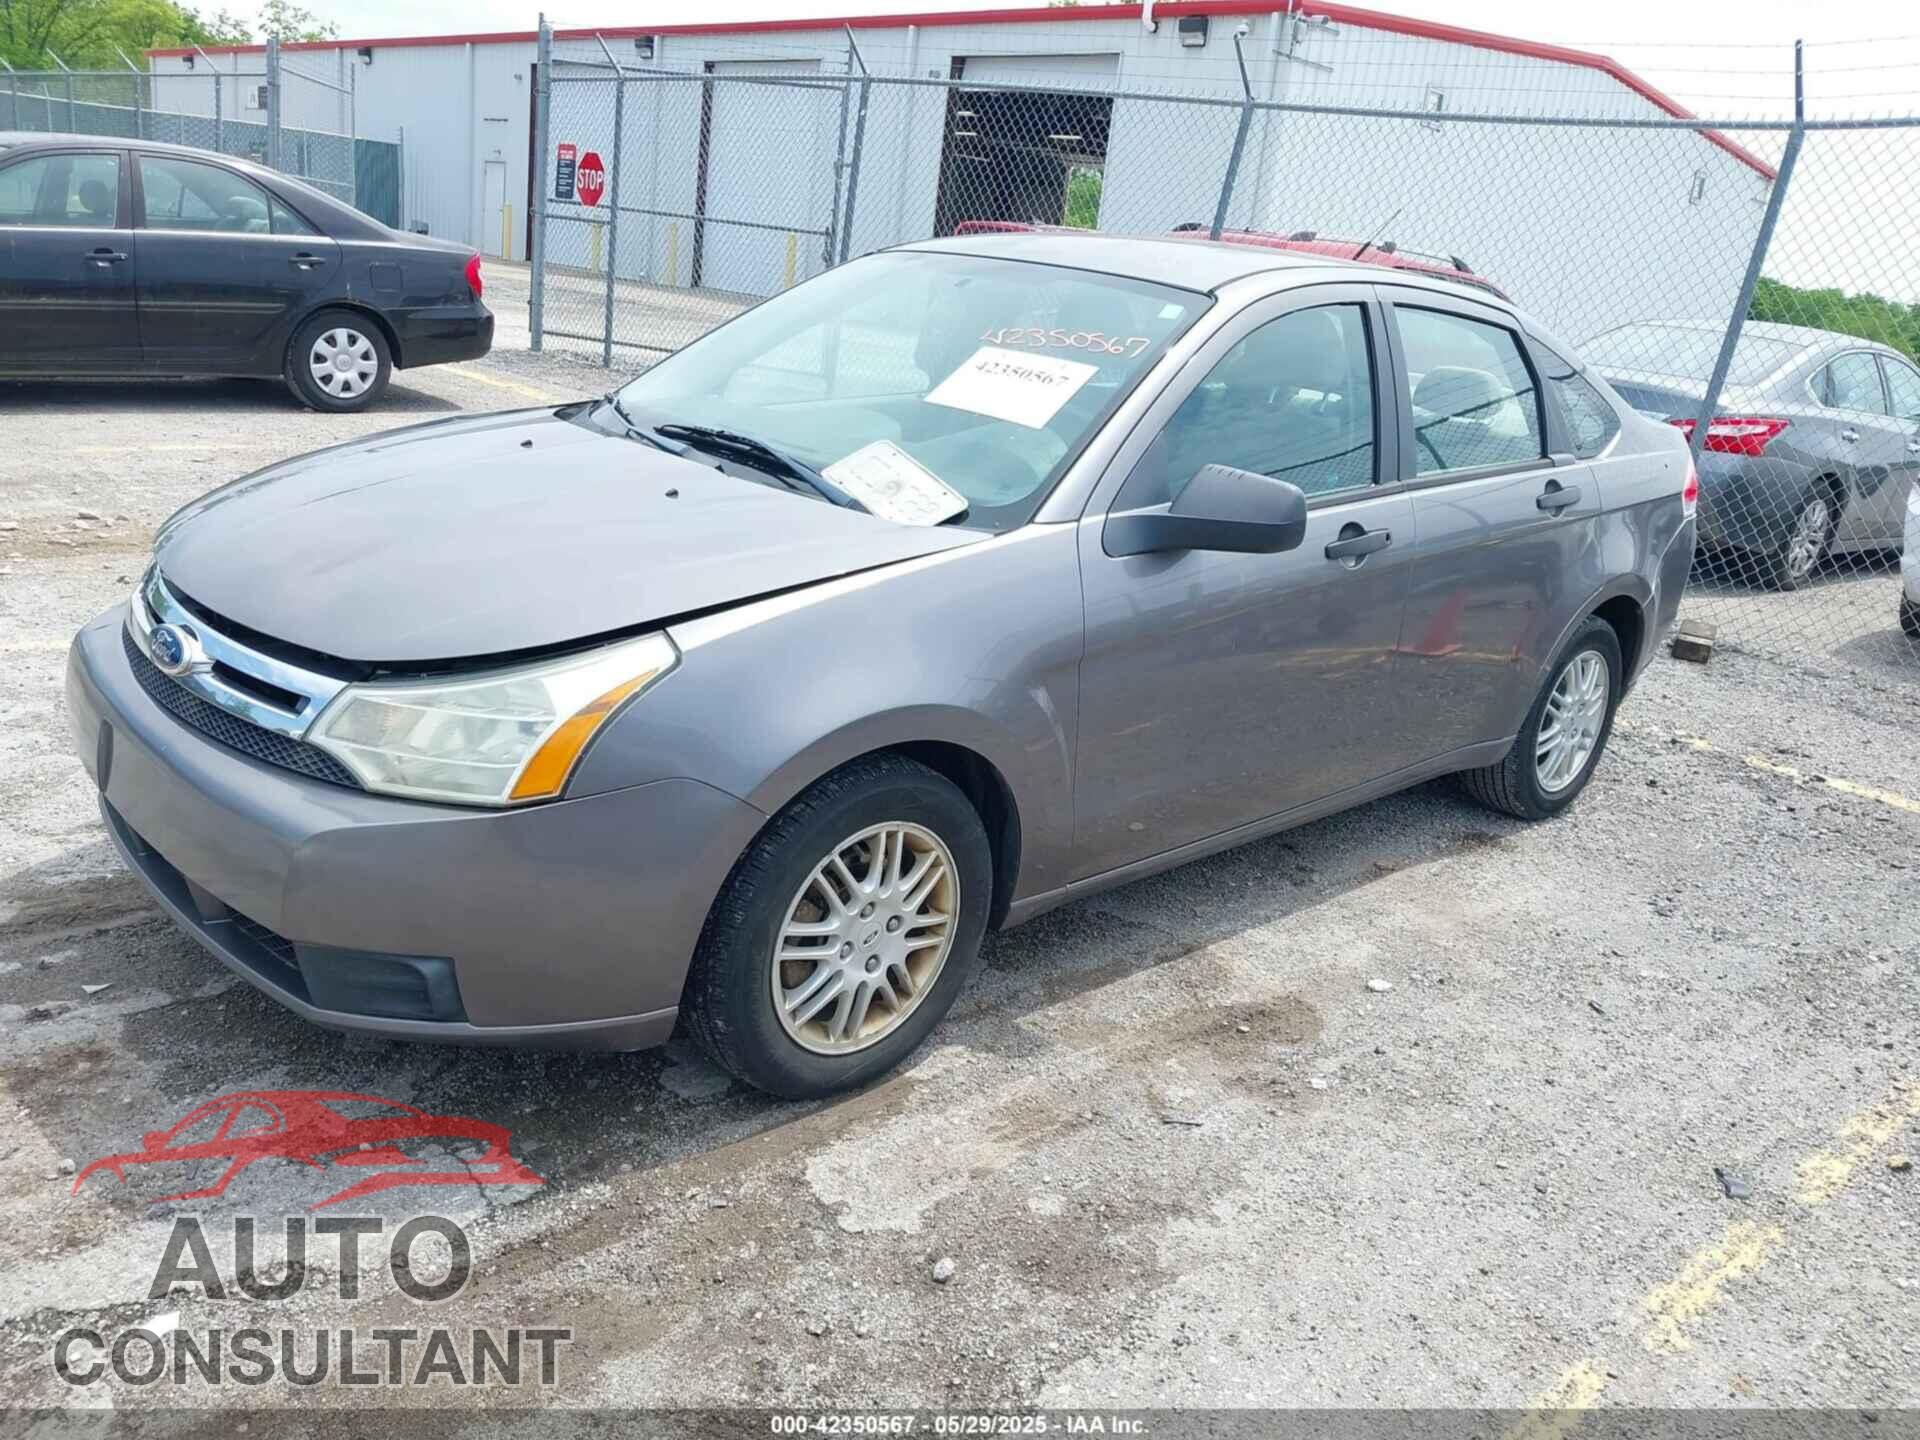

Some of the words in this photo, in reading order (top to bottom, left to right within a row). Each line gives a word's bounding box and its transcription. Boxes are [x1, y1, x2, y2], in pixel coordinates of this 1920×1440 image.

[578, 169, 603, 190] STOP
[979, 327, 1151, 358] 42350567
[974, 360, 1070, 386] 42350567
